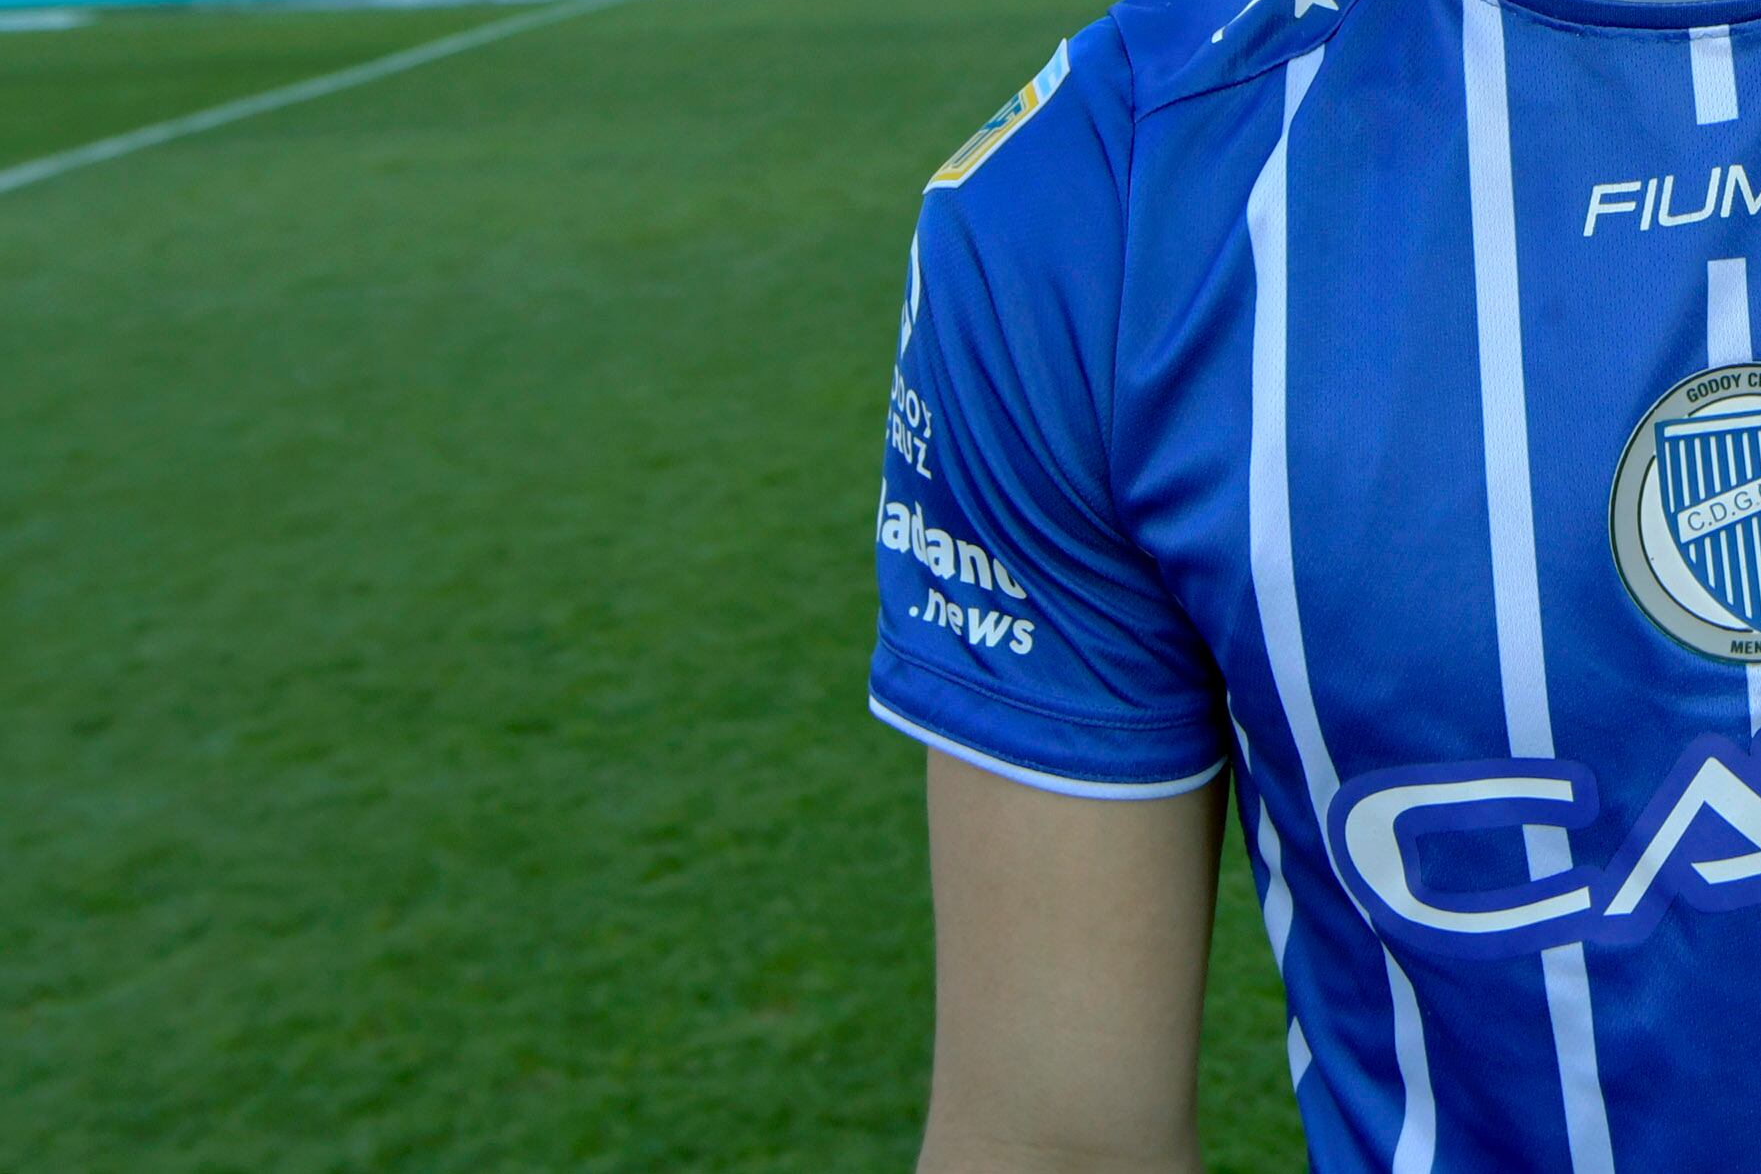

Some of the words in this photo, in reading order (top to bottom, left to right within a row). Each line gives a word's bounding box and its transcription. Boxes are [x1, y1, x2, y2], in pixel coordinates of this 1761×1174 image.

[1686, 373, 1742, 403] GODOY
[886, 407, 932, 480] RUZ
[909, 589, 1036, 655] .news
